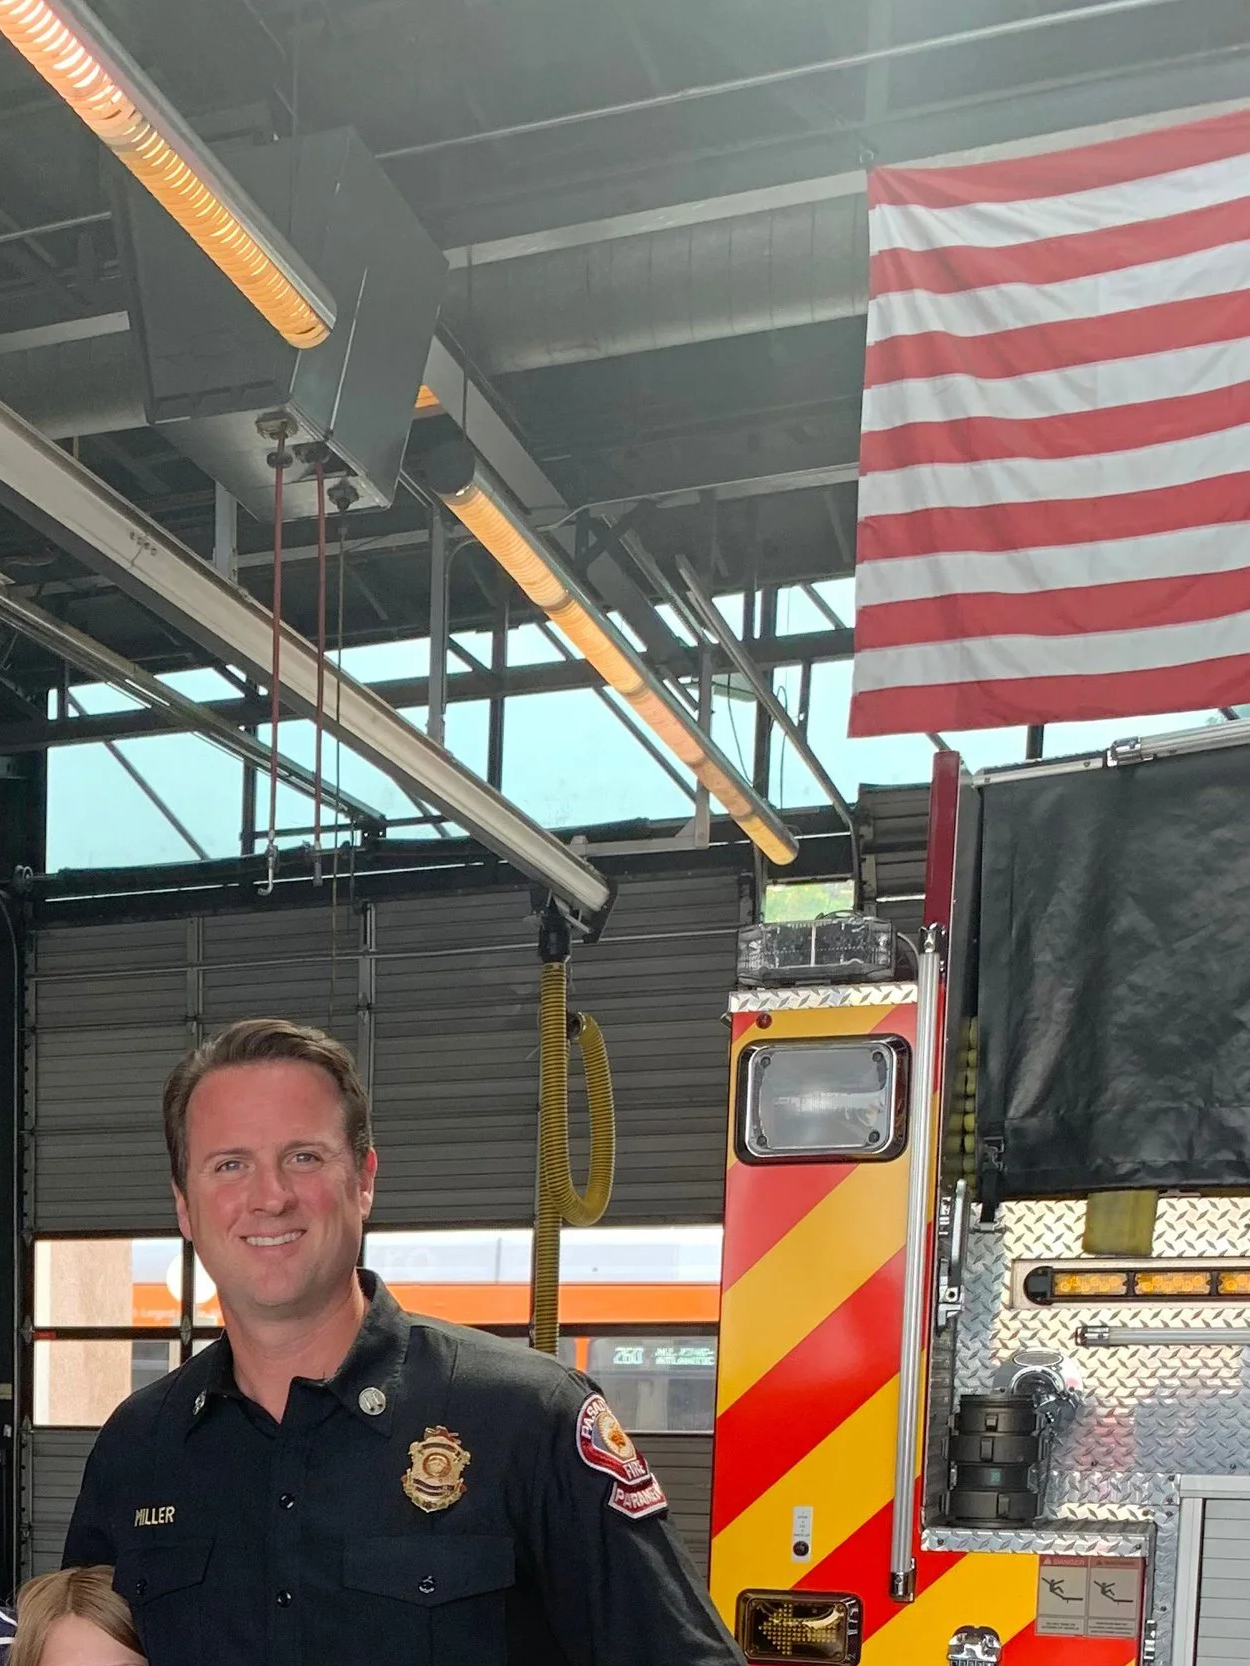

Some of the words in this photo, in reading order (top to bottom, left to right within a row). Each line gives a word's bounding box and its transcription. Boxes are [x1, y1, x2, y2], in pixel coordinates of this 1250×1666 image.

[623, 1461, 646, 1479] FIRE
[134, 1506, 176, 1527] MILLER
[1053, 1558, 1085, 1566] DANGER
